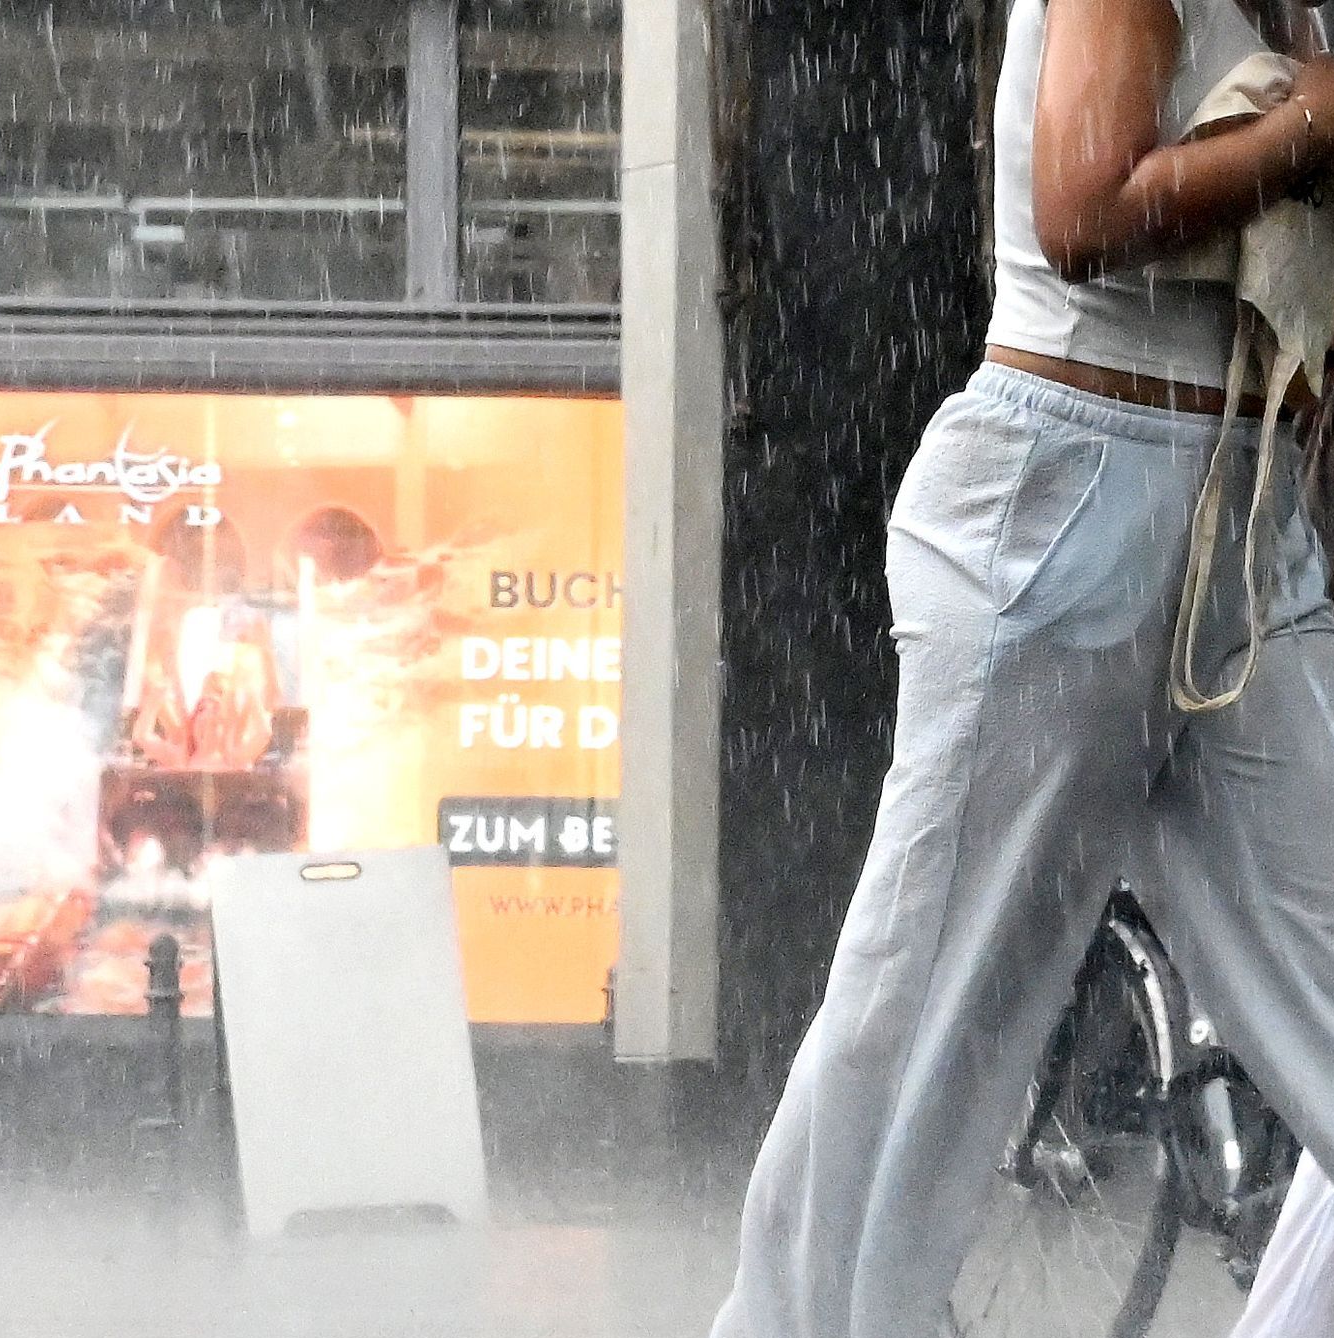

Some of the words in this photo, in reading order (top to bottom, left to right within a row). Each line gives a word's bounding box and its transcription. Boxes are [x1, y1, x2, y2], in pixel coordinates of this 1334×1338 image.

[461, 636, 621, 682] DEINE
[460, 693, 564, 749] FÜR
[449, 814, 545, 854] ZUM
